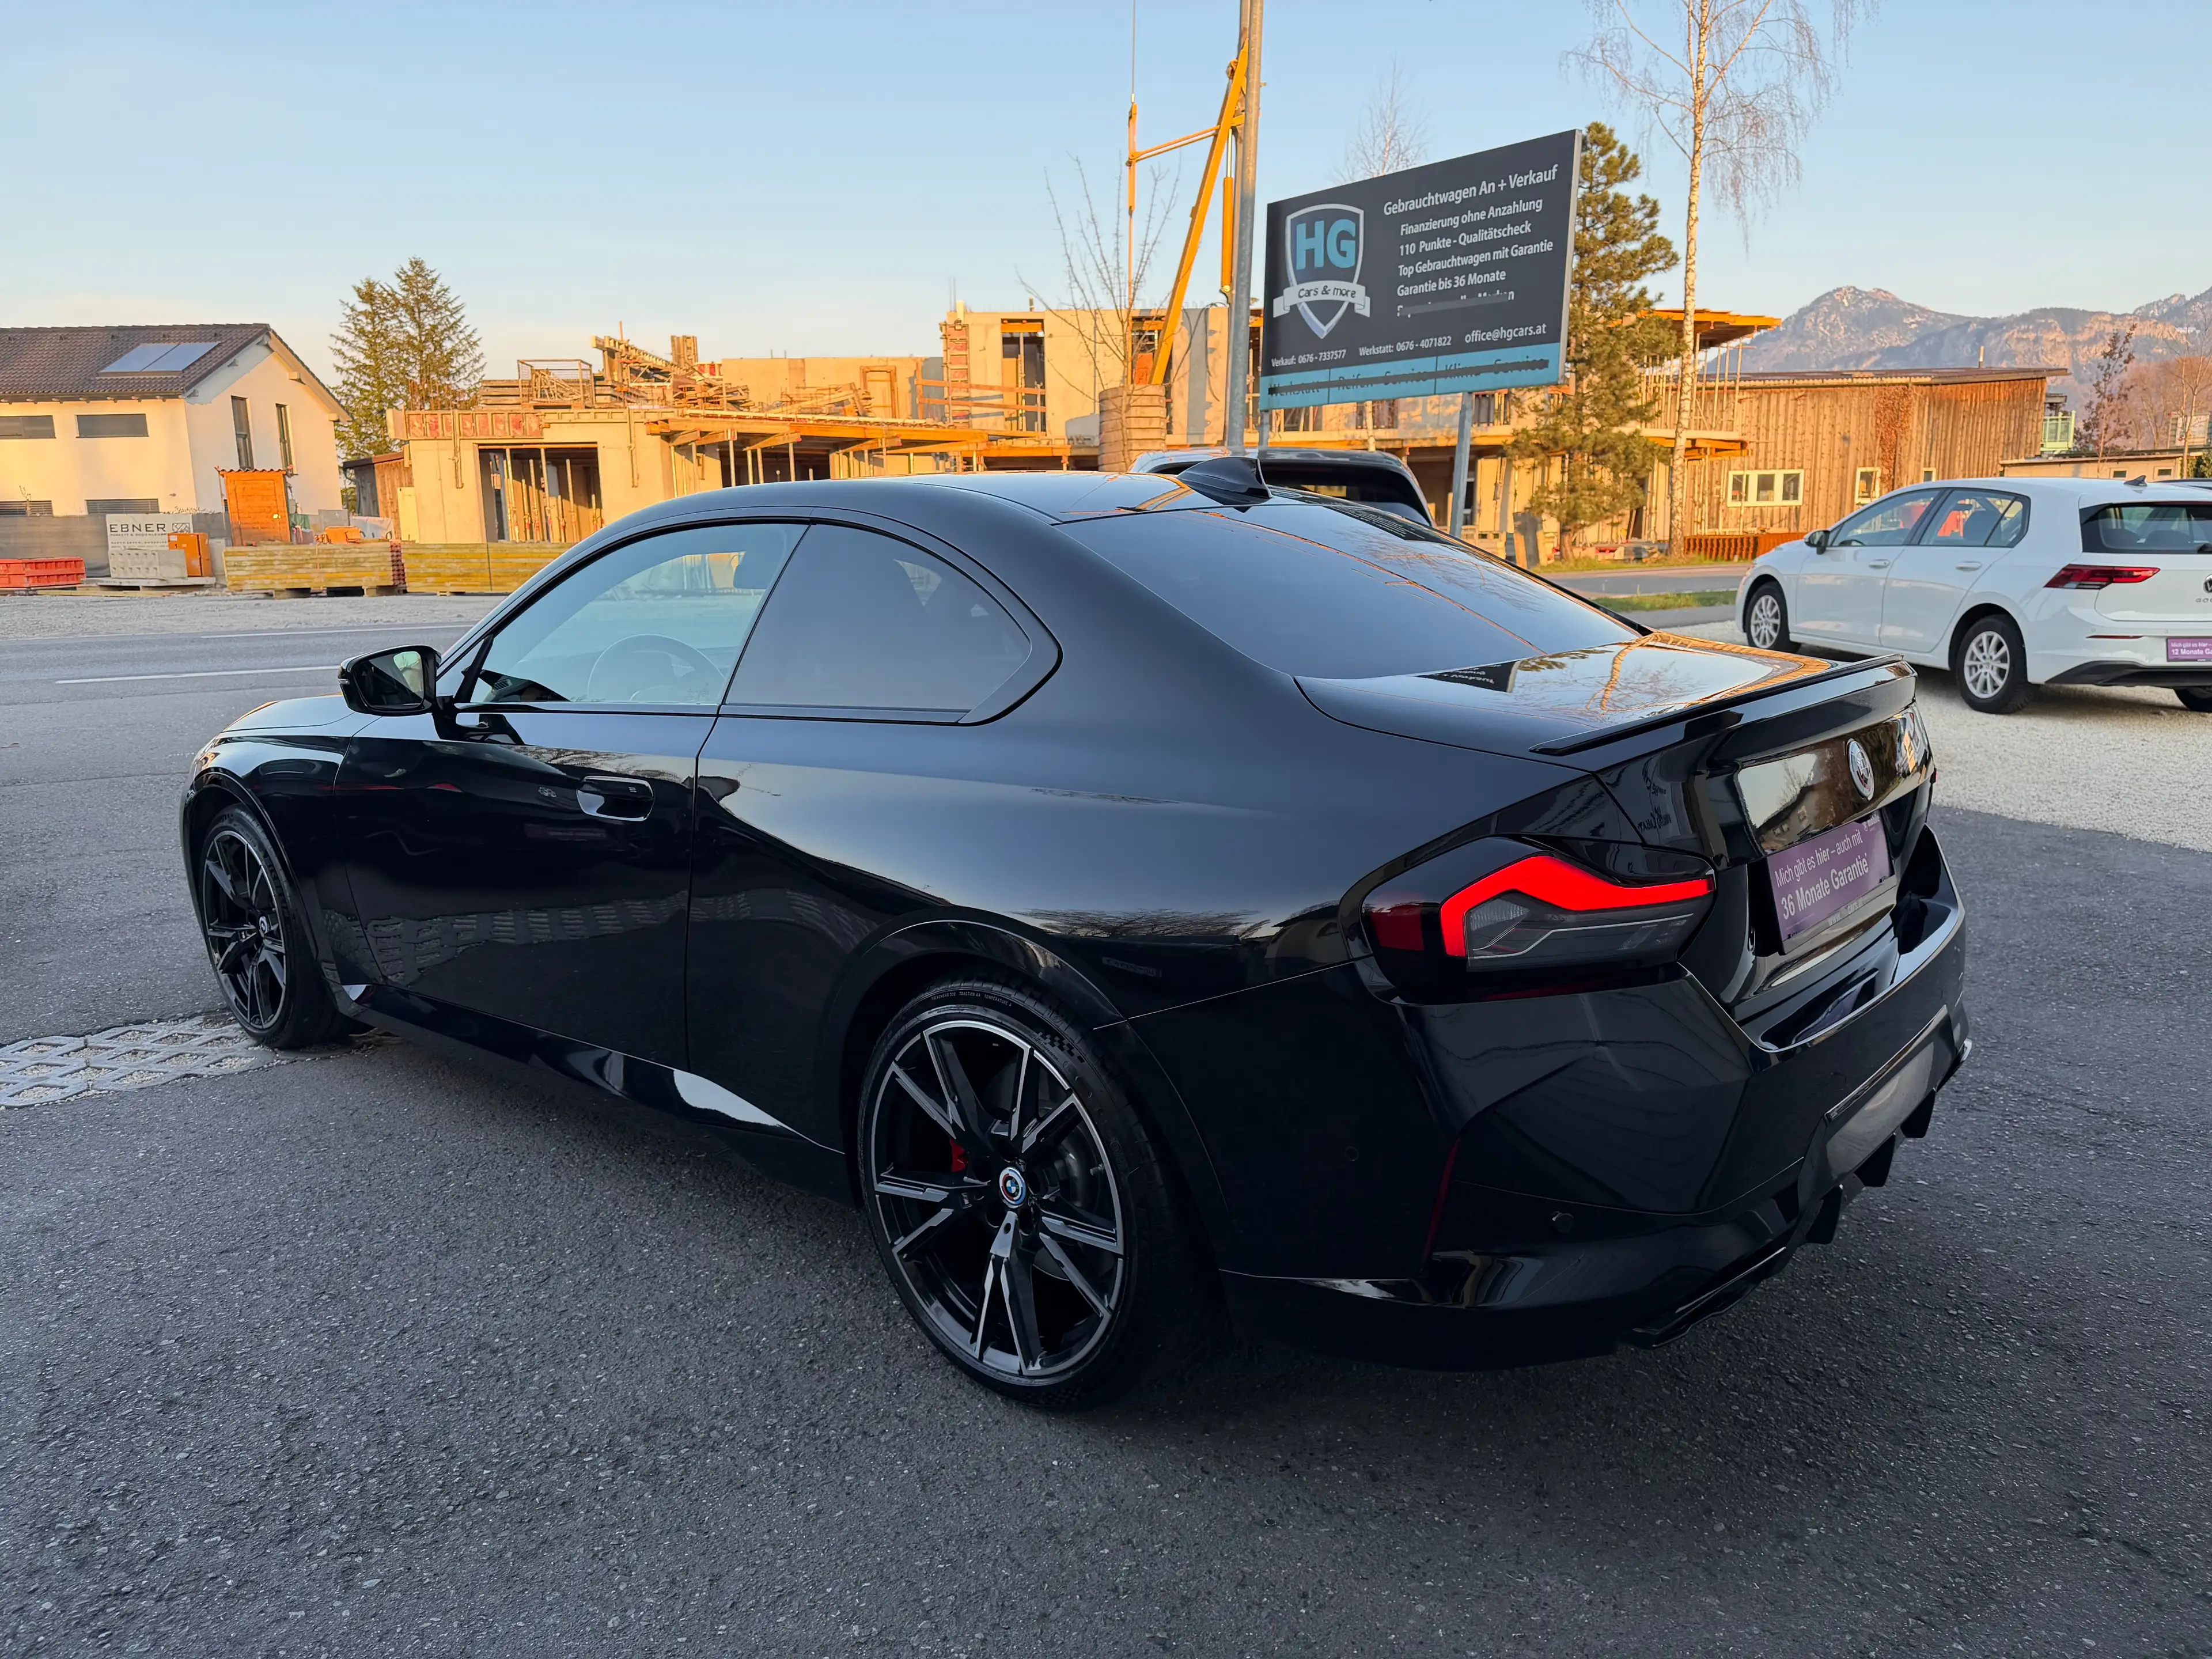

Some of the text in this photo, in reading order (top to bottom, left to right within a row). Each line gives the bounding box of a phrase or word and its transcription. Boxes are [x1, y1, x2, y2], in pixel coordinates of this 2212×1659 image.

[1384, 164, 1558, 215] Gebrauchtwagen An + Verkauf
[1400, 198, 1543, 236] Finanzierung ohne Anzahlung
[1296, 218, 1356, 271] HG
[1400, 243, 1416, 256] 110
[1419, 237, 1452, 252] Punkte
[1459, 220, 1532, 245] Qualitätscheck
[1398, 238, 1554, 278] Top Gebrauchtwagen mit Garantie
[1298, 285, 1356, 298] Cars & more
[1397, 270, 1506, 297] Garantie bis 36 Monate
[1359, 346, 1393, 357] Werkstatt:
[1396, 340, 1414, 352] 0676
[1419, 336, 1452, 349] 4071822
[1465, 323, 1547, 343] office@hgcars.at
[1271, 355, 1296, 367] Verkauf:
[1298, 353, 1314, 364] 0676
[1318, 349, 1347, 362] 7337577
[109, 524, 166, 533] EBNER
[1775, 866, 1794, 888] Mich
[1794, 857, 1808, 882] gibt
[1806, 856, 1816, 870] es
[1815, 847, 1830, 866] hier
[1836, 835, 1852, 855] auch
[1851, 829, 1863, 846] mit
[1781, 893, 1796, 919] 36
[1795, 877, 1831, 912] Monate
